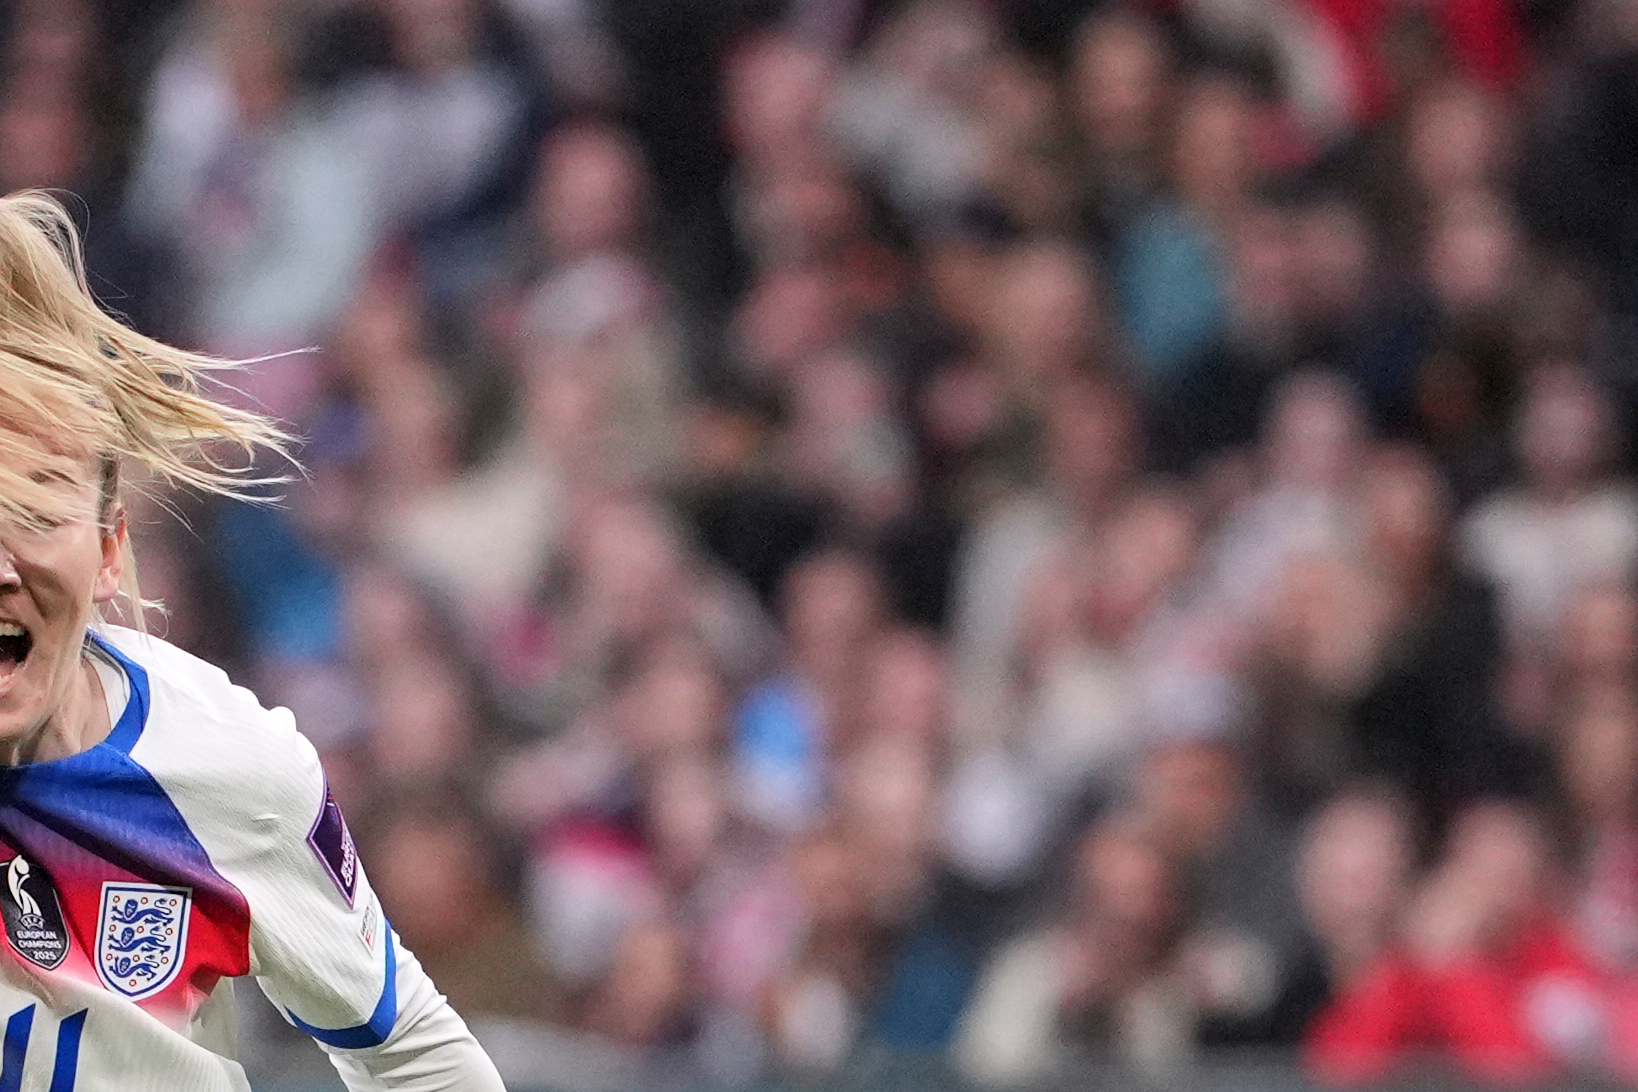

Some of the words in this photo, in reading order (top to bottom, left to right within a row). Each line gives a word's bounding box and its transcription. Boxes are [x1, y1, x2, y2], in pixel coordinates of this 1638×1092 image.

[16, 930, 58, 940] EUROPEAN
[18, 939, 62, 949] CHAMPIONS
[32, 950, 57, 961] 2025
